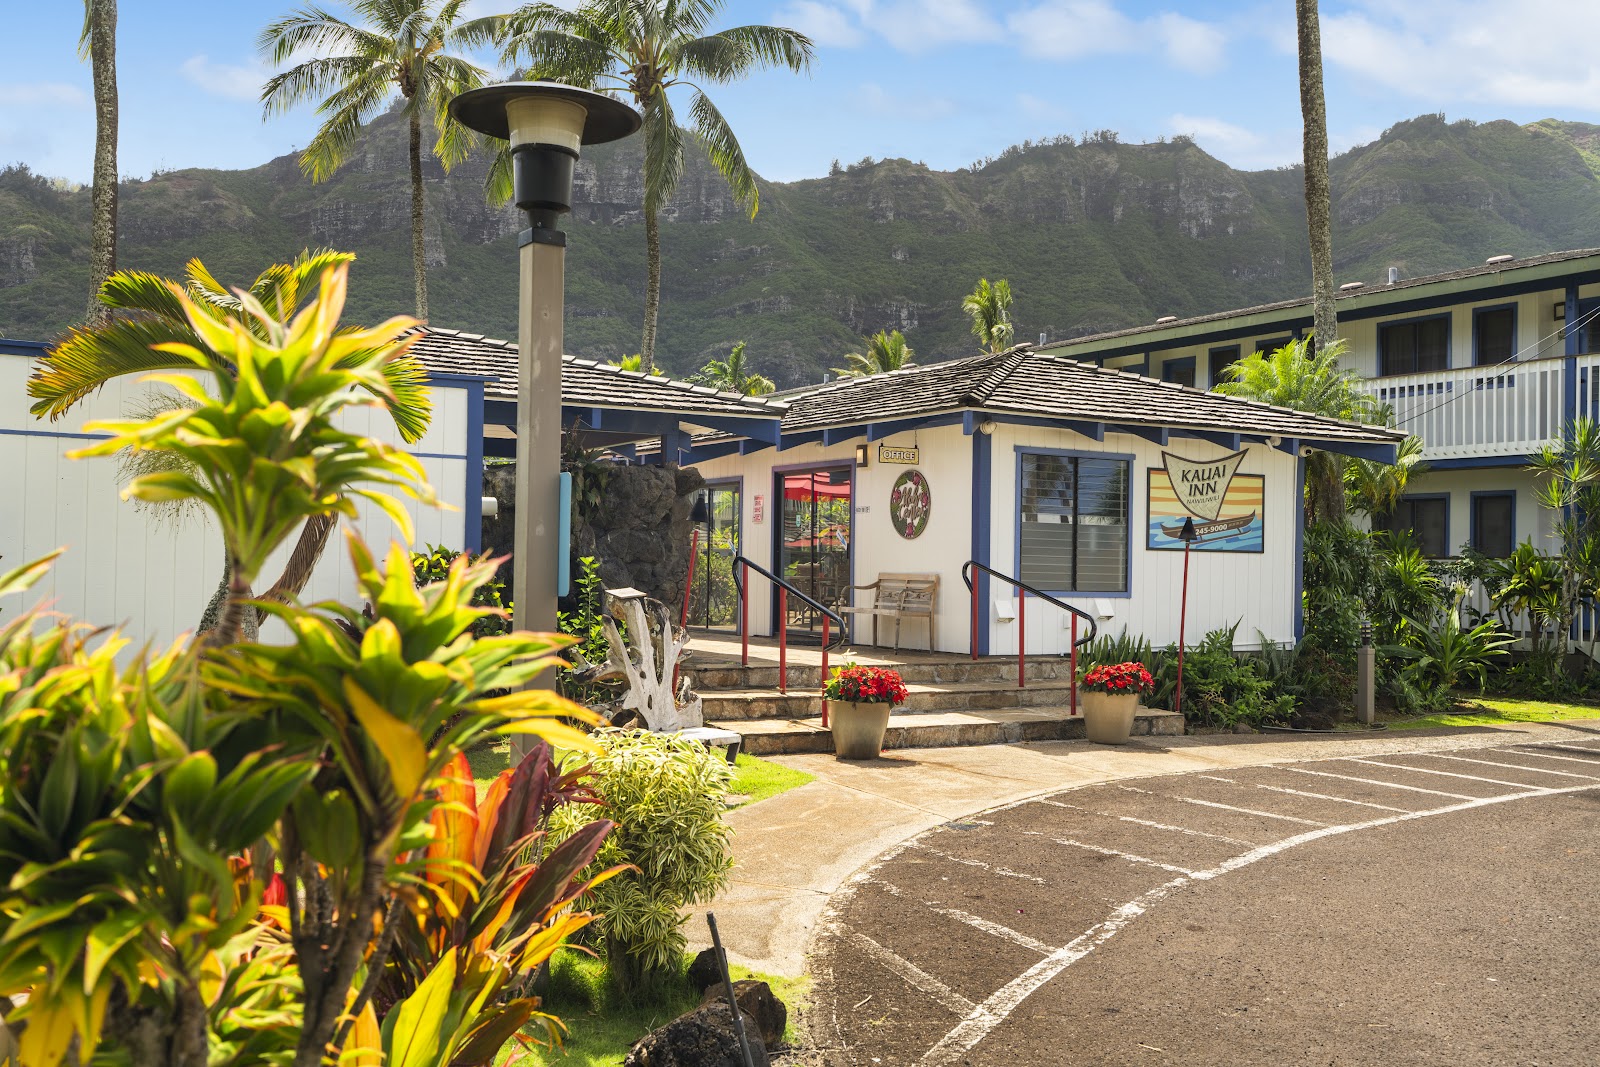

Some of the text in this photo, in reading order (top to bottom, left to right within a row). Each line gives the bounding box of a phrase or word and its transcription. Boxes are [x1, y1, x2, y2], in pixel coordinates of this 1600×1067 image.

[883, 450, 915, 461] OFFICE
[1181, 464, 1226, 483] KAUAI
[1188, 481, 1218, 497] INN
[1195, 524, 1228, 535] 245-9000
